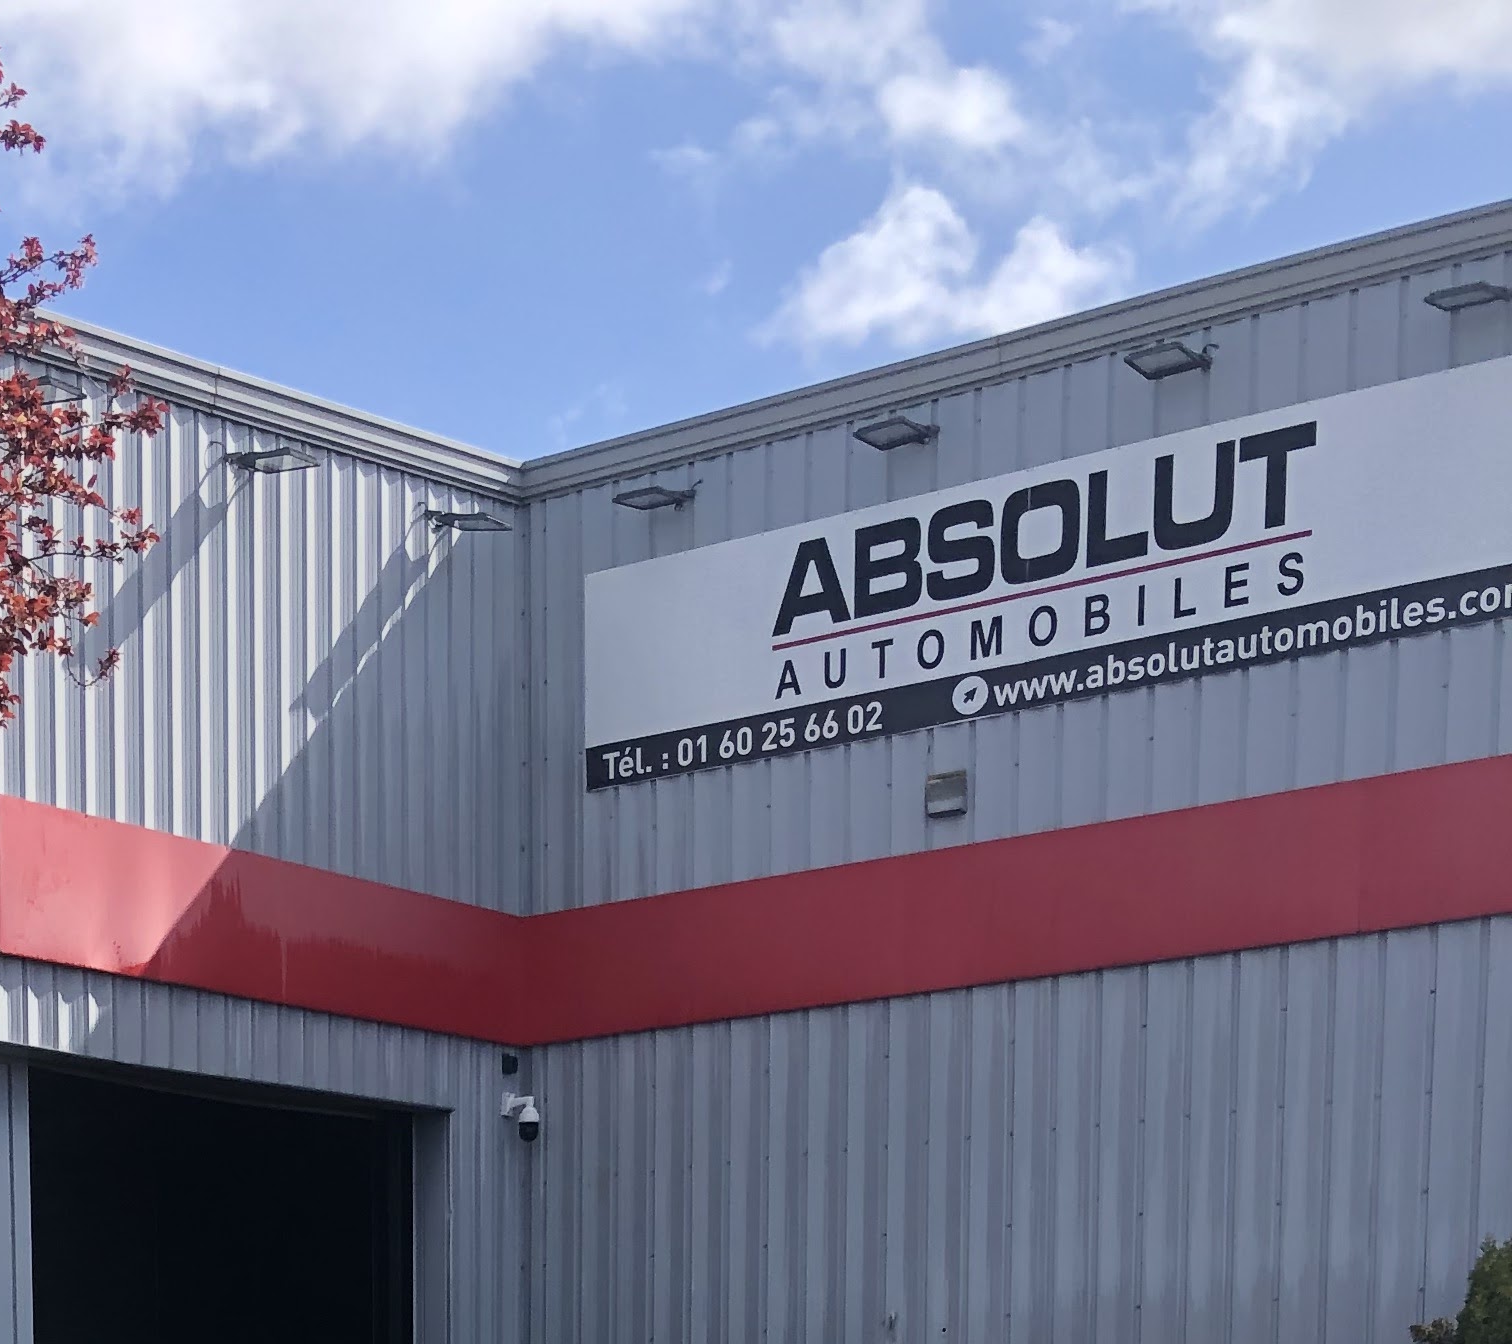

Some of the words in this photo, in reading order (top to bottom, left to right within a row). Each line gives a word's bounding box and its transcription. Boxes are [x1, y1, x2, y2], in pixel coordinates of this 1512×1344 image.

[771, 420, 1317, 637] ABSOLUT
[775, 551, 1306, 701] AUTOMOBILES
[601, 747, 653, 781] Tél.
[677, 734, 709, 767] 01
[718, 726, 754, 760] 60
[760, 717, 797, 752] 25
[803, 709, 840, 744] 66
[846, 701, 884, 735] 02
